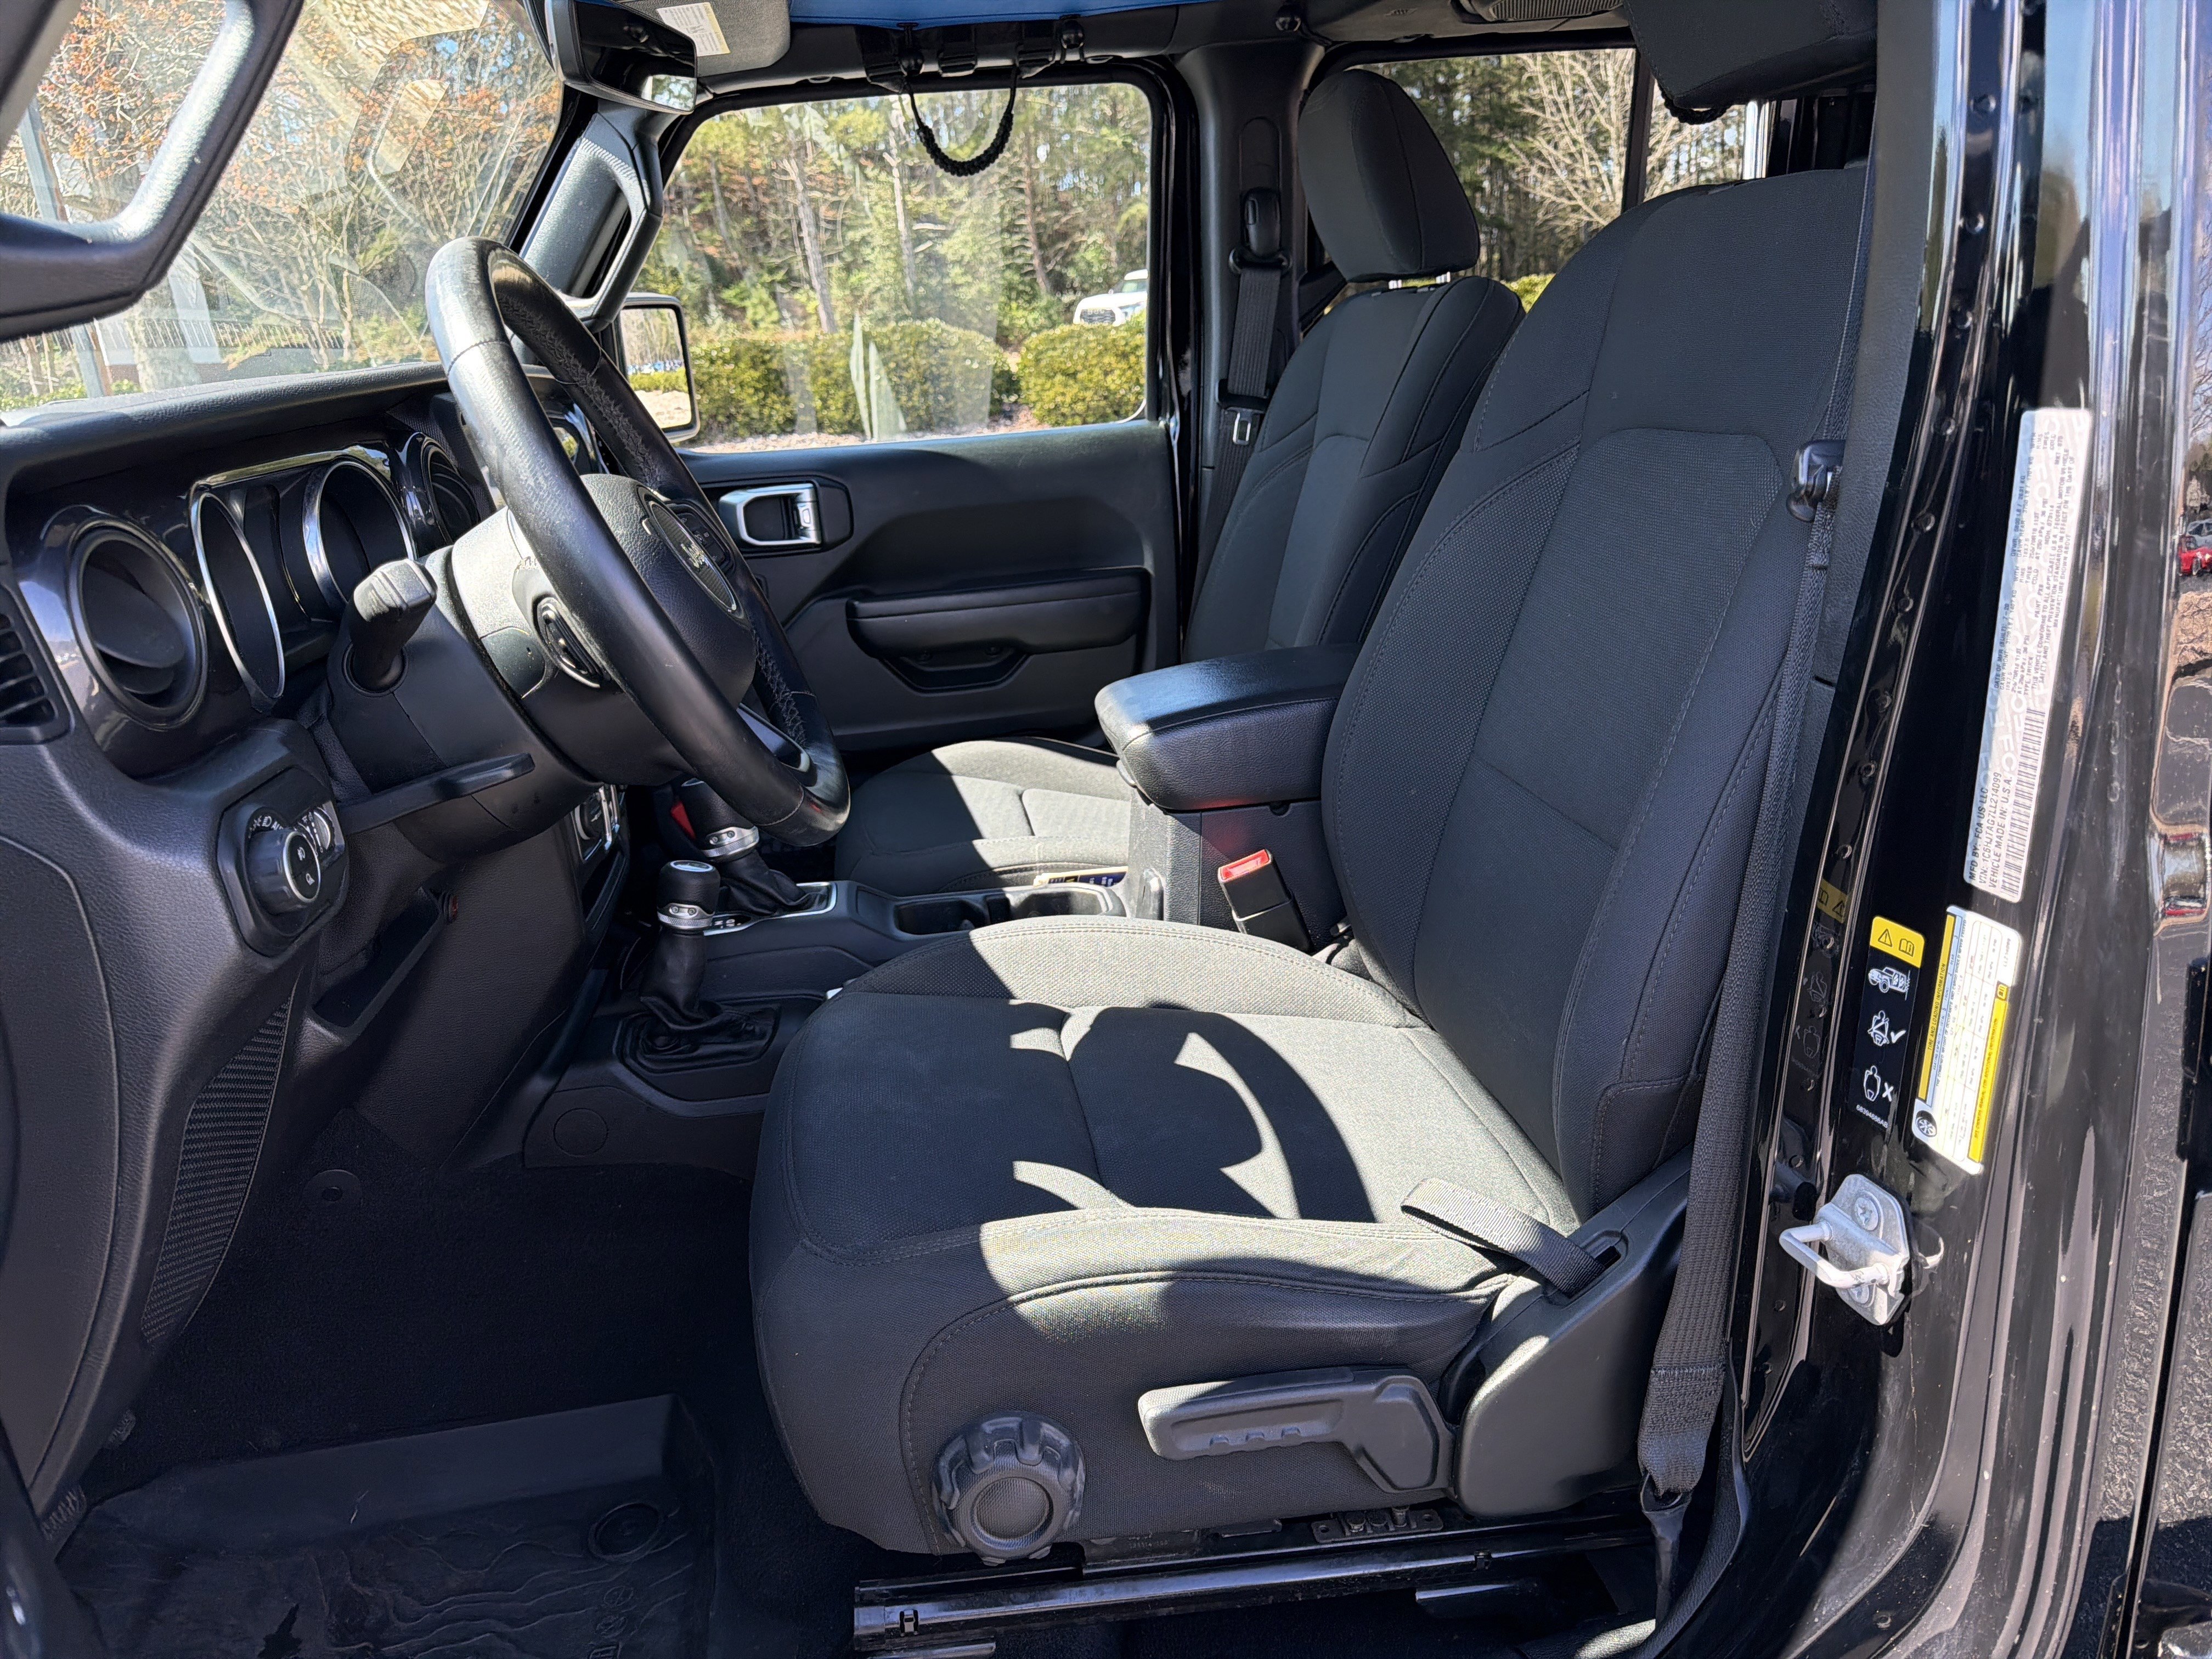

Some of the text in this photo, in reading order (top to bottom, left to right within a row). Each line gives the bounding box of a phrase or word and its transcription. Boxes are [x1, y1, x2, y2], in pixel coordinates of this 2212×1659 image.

[1978, 787, 1988, 804] LLC
[1976, 806, 1985, 819] US
[1973, 822, 1983, 839] FCA
[1988, 777, 2012, 888] VEHICLE MADE IN: U.S.A.
[1968, 860, 1978, 880] MFD
[1978, 866, 1988, 883] VIN:
[1936, 963, 1945, 1000] INFORMATION
